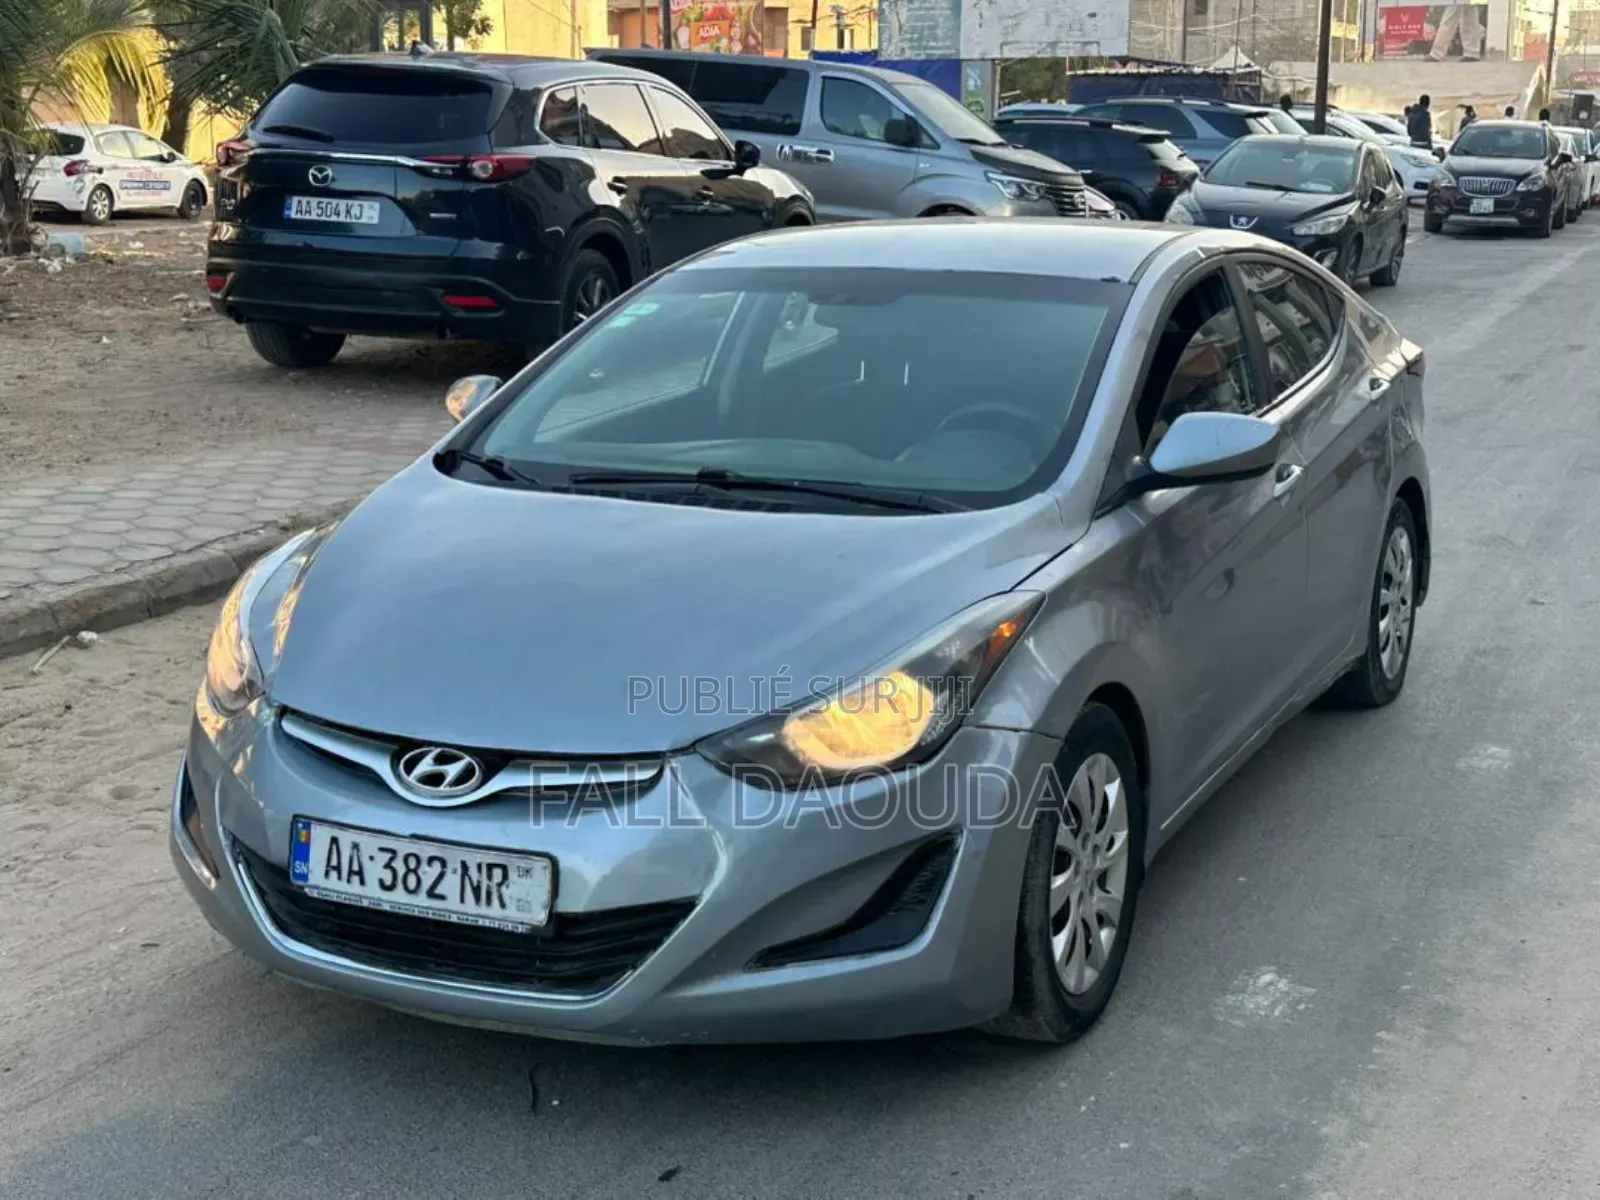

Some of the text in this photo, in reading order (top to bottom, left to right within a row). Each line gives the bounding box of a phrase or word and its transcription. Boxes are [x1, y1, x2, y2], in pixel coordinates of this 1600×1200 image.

[295, 199, 312, 217] AA
[316, 201, 341, 219] 504
[345, 203, 364, 220] KJ
[293, 861, 308, 874] SN
[324, 835, 510, 909] AA 382 NR
